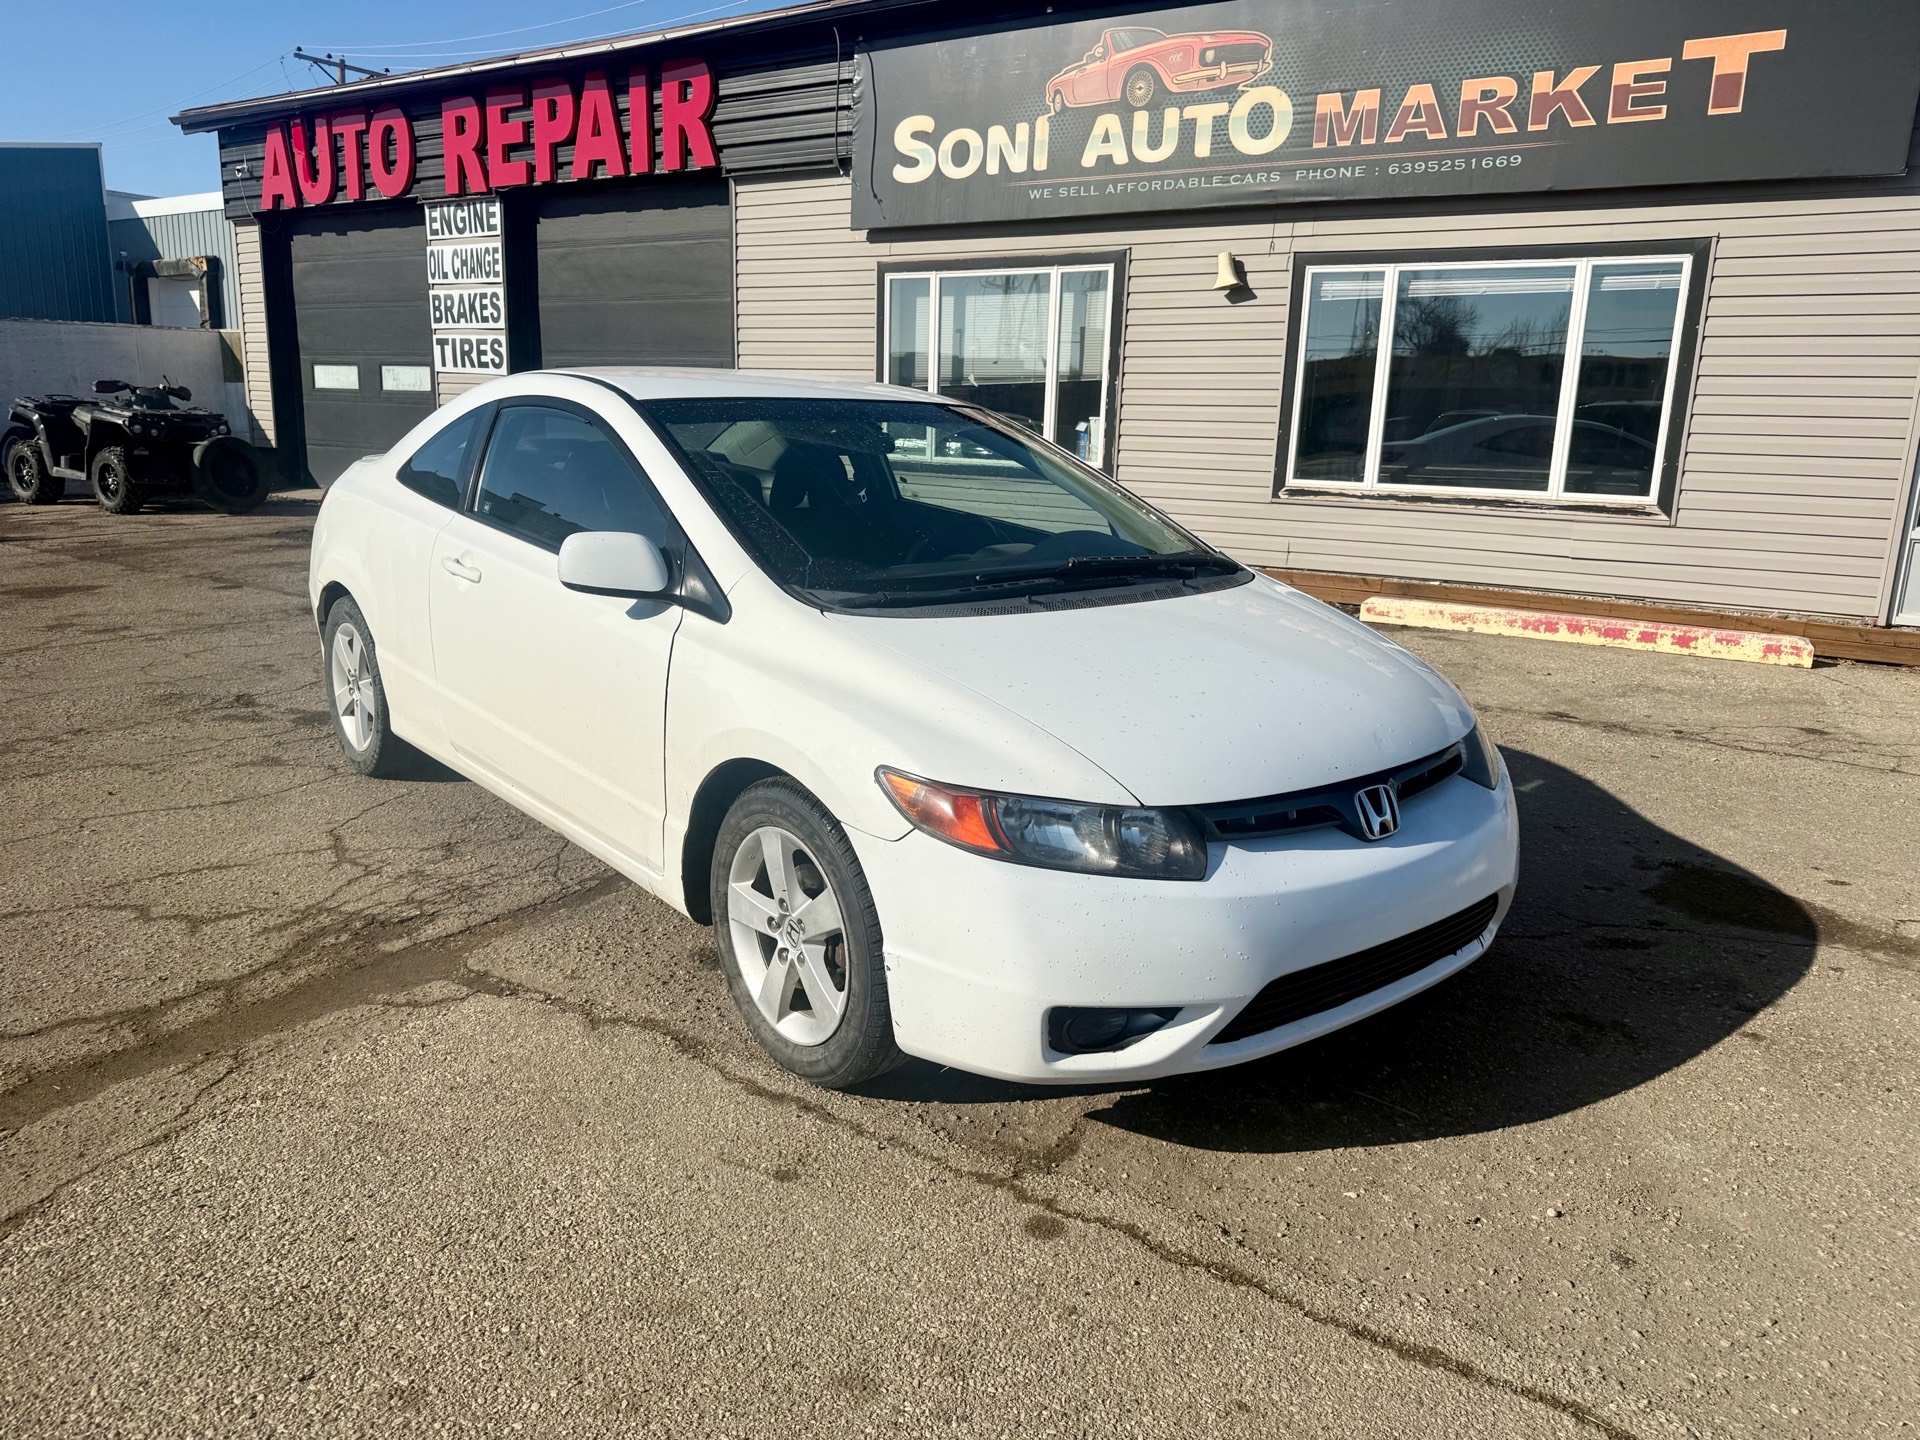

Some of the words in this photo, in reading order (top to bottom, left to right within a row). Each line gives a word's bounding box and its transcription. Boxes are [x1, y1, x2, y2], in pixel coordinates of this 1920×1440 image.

[260, 103, 417, 212] AUTO
[442, 57, 720, 195] REPAIR
[1080, 86, 1294, 169] AUTO
[1028, 188, 1052, 200] WE
[1058, 185, 1100, 198] SELL
[1105, 175, 1224, 195] AFFORDABLE
[1229, 171, 1281, 185] CARS
[1295, 165, 1367, 181] PHONE
[1387, 154, 1523, 176] 6395251669
[428, 201, 498, 237] ENGINE
[428, 249, 449, 281] OIL
[451, 246, 500, 281] CHANGE
[431, 291, 502, 325] BRAKES
[435, 337, 505, 370] TIRES
